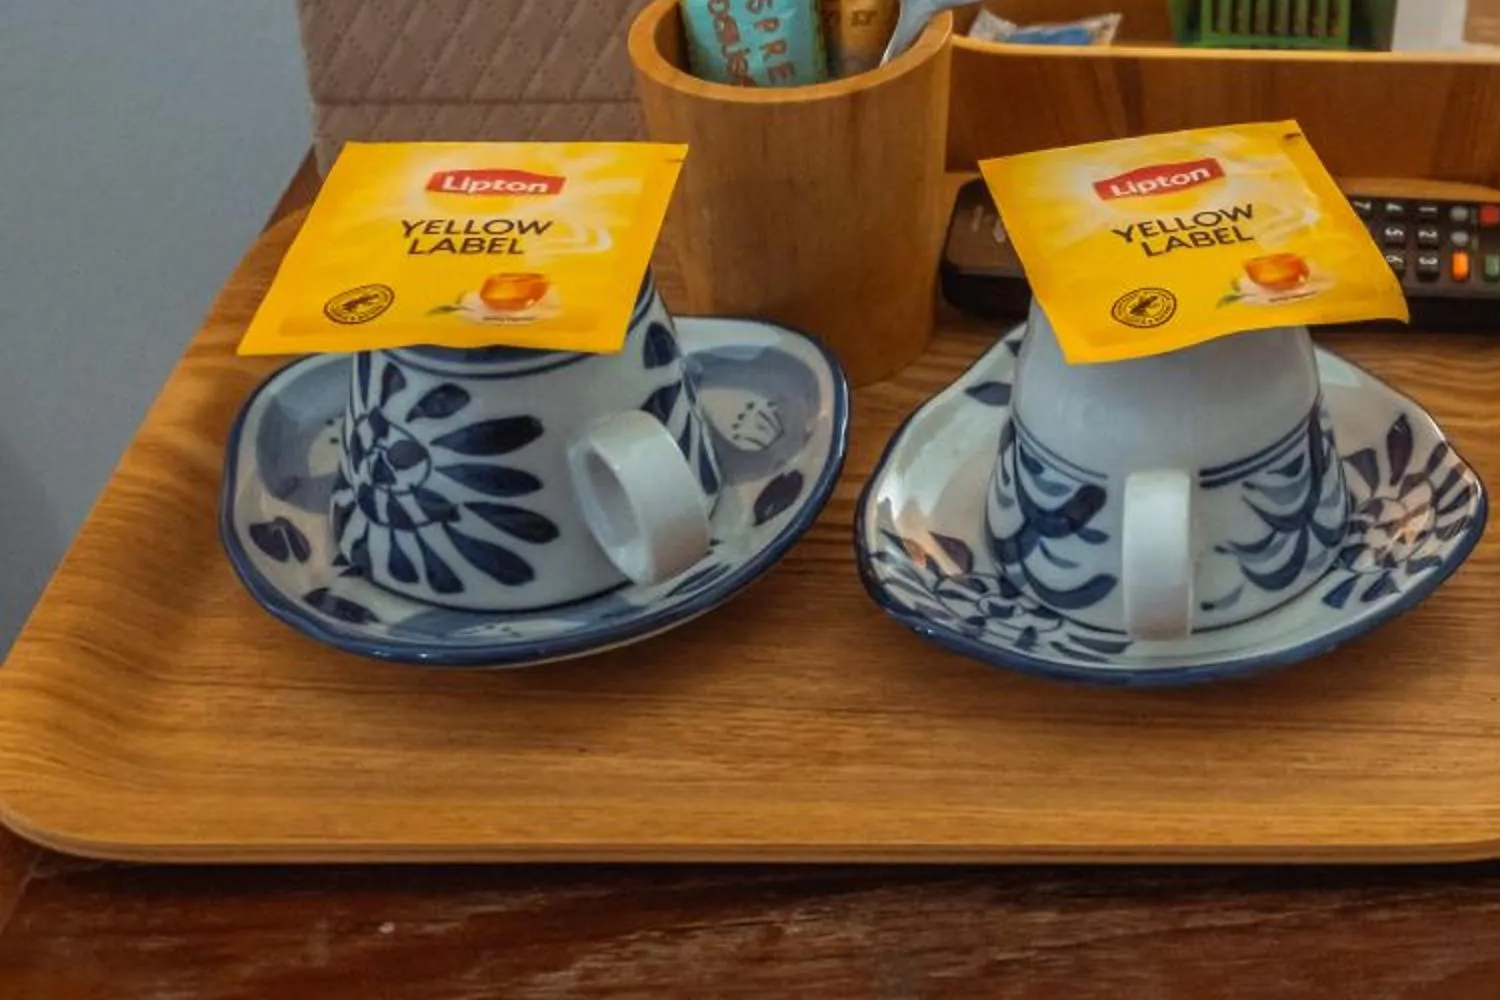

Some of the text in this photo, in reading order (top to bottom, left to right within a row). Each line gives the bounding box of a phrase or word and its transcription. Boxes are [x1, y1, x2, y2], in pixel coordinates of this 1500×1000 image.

[442, 174, 549, 196] Lipton
[1110, 165, 1211, 198] Lipton
[401, 218, 554, 239] YELLOW
[1111, 203, 1254, 244] YELLOW
[1384, 227, 1404, 237] 5
[1418, 229, 1438, 239] 2
[407, 237, 526, 255] LABEL
[1141, 225, 1255, 258] LABEL
[1418, 256, 1438, 265] 3
